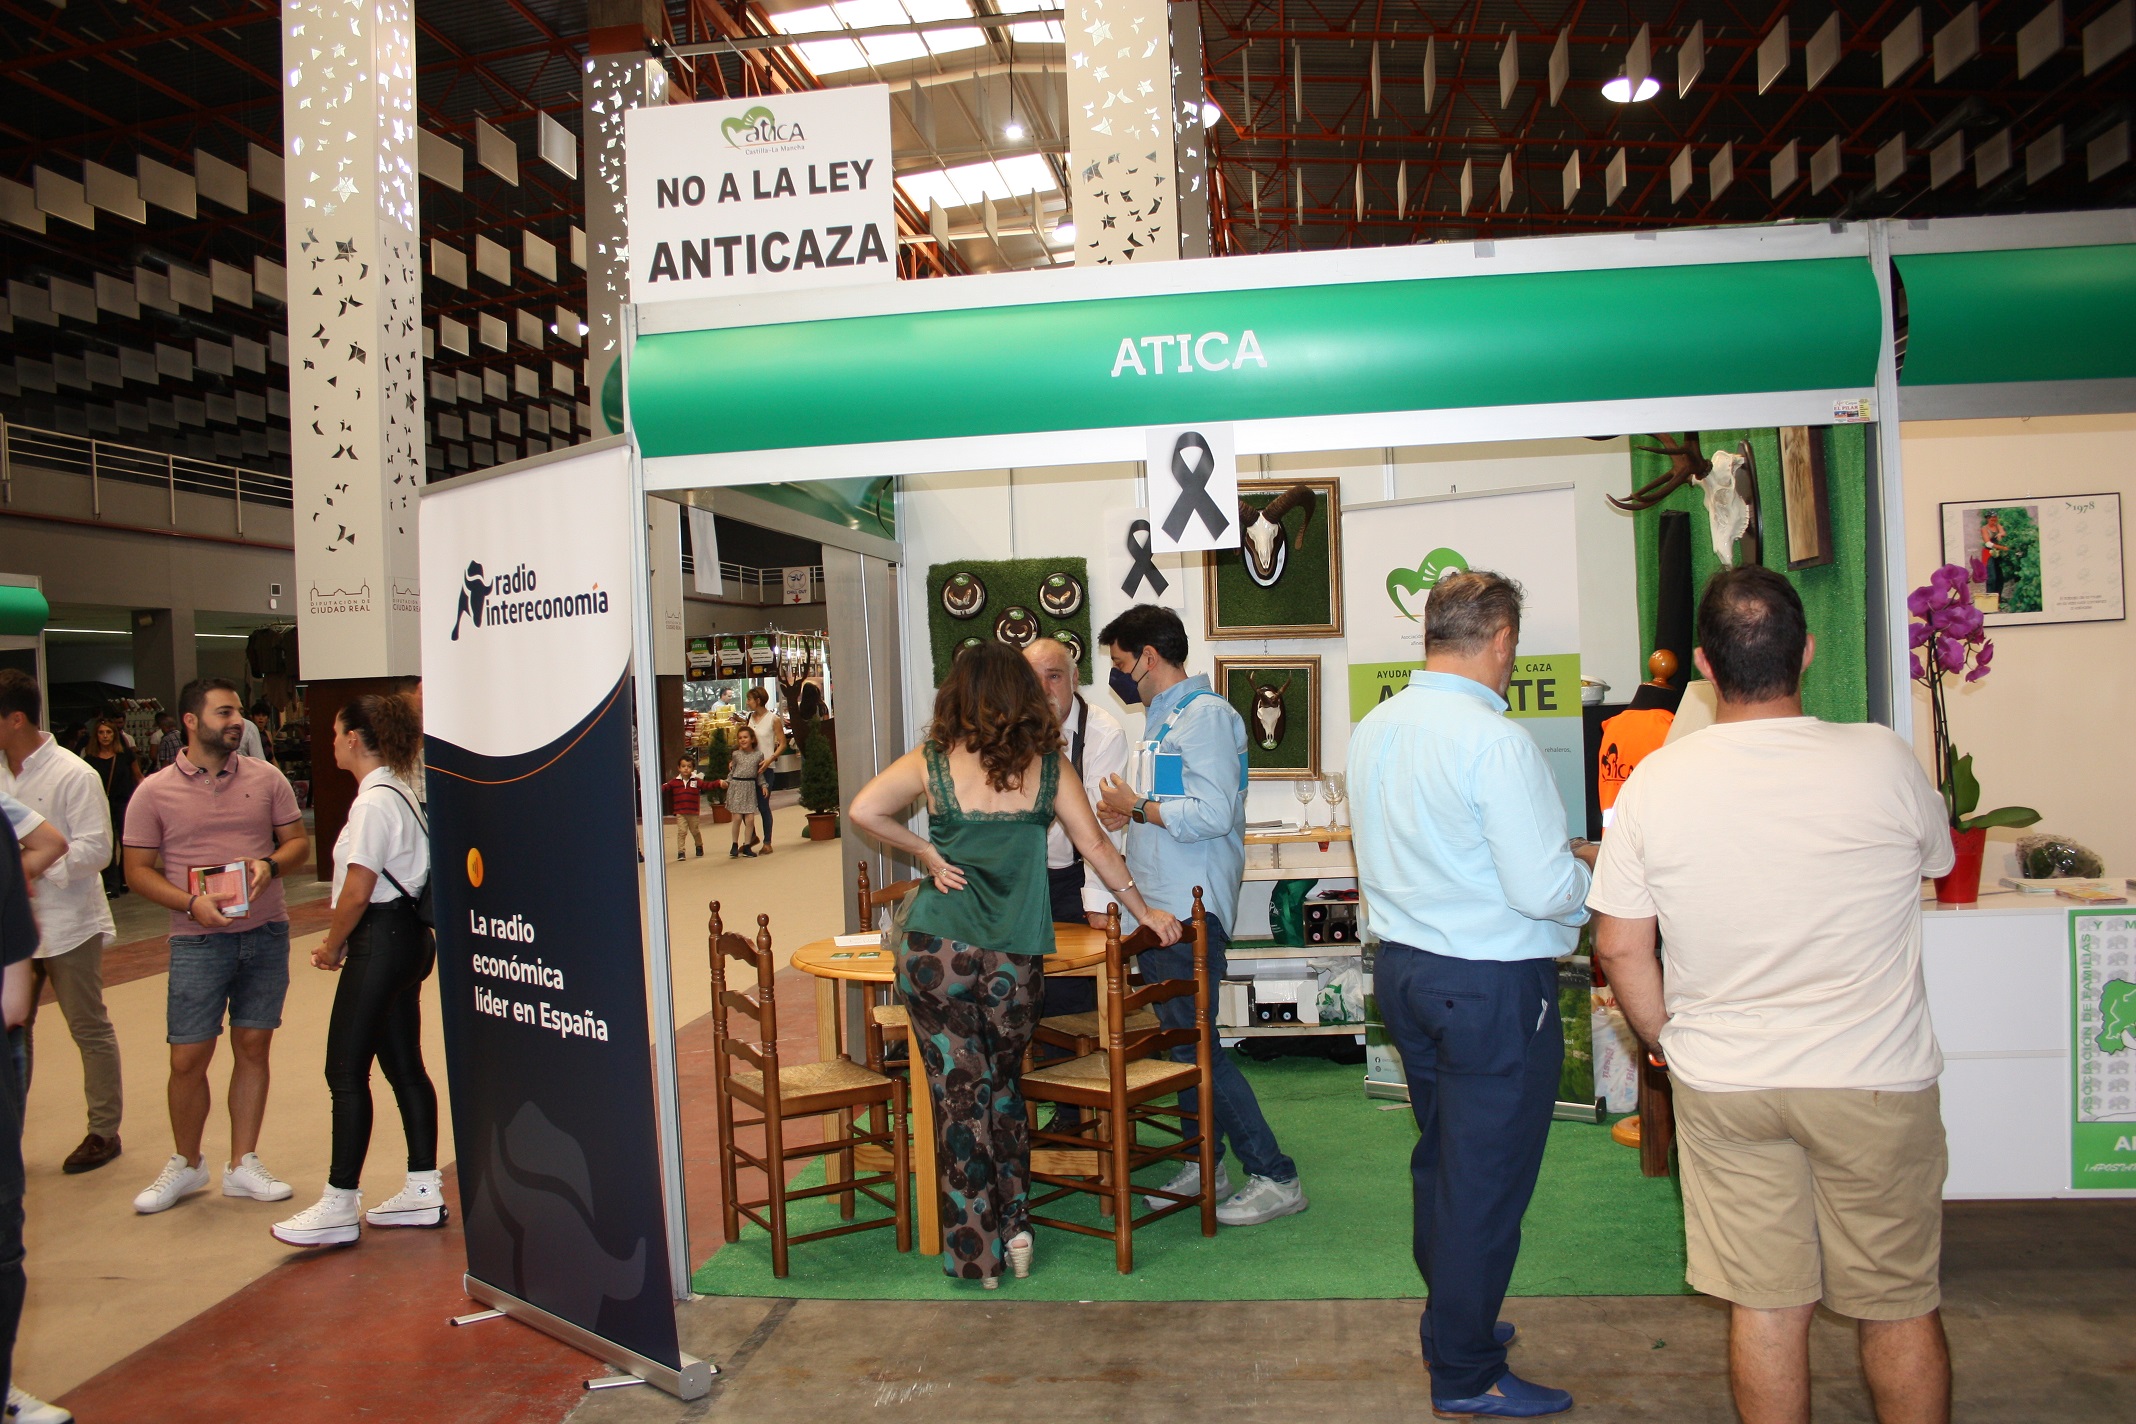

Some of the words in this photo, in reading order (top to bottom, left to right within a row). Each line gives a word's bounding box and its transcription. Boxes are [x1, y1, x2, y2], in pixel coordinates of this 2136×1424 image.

[780, 144, 805, 153] Mancha
[657, 175, 706, 209] NO
[717, 172, 741, 203] A
[753, 167, 796, 200] LA
[808, 158, 874, 195] LEY
[648, 222, 889, 283] ANTICAZA
[1110, 329, 1268, 378] ATICA
[495, 563, 537, 596] radio
[310, 605, 346, 615] CIUDAD
[349, 604, 371, 613] REAL
[486, 582, 609, 627] intereconomía
[1526, 663, 1552, 672] CAZA
[470, 909, 487, 936] La
[491, 914, 535, 944] radio
[473, 953, 564, 990] económica
[2082, 933, 2092, 999] FAMILIAS
[474, 985, 509, 1019] líder
[513, 1001, 535, 1025] en
[540, 1001, 608, 1042] España
[2083, 1003, 2092, 1022] DE
[2083, 1026, 2093, 1115] ASOCIACIÓN
